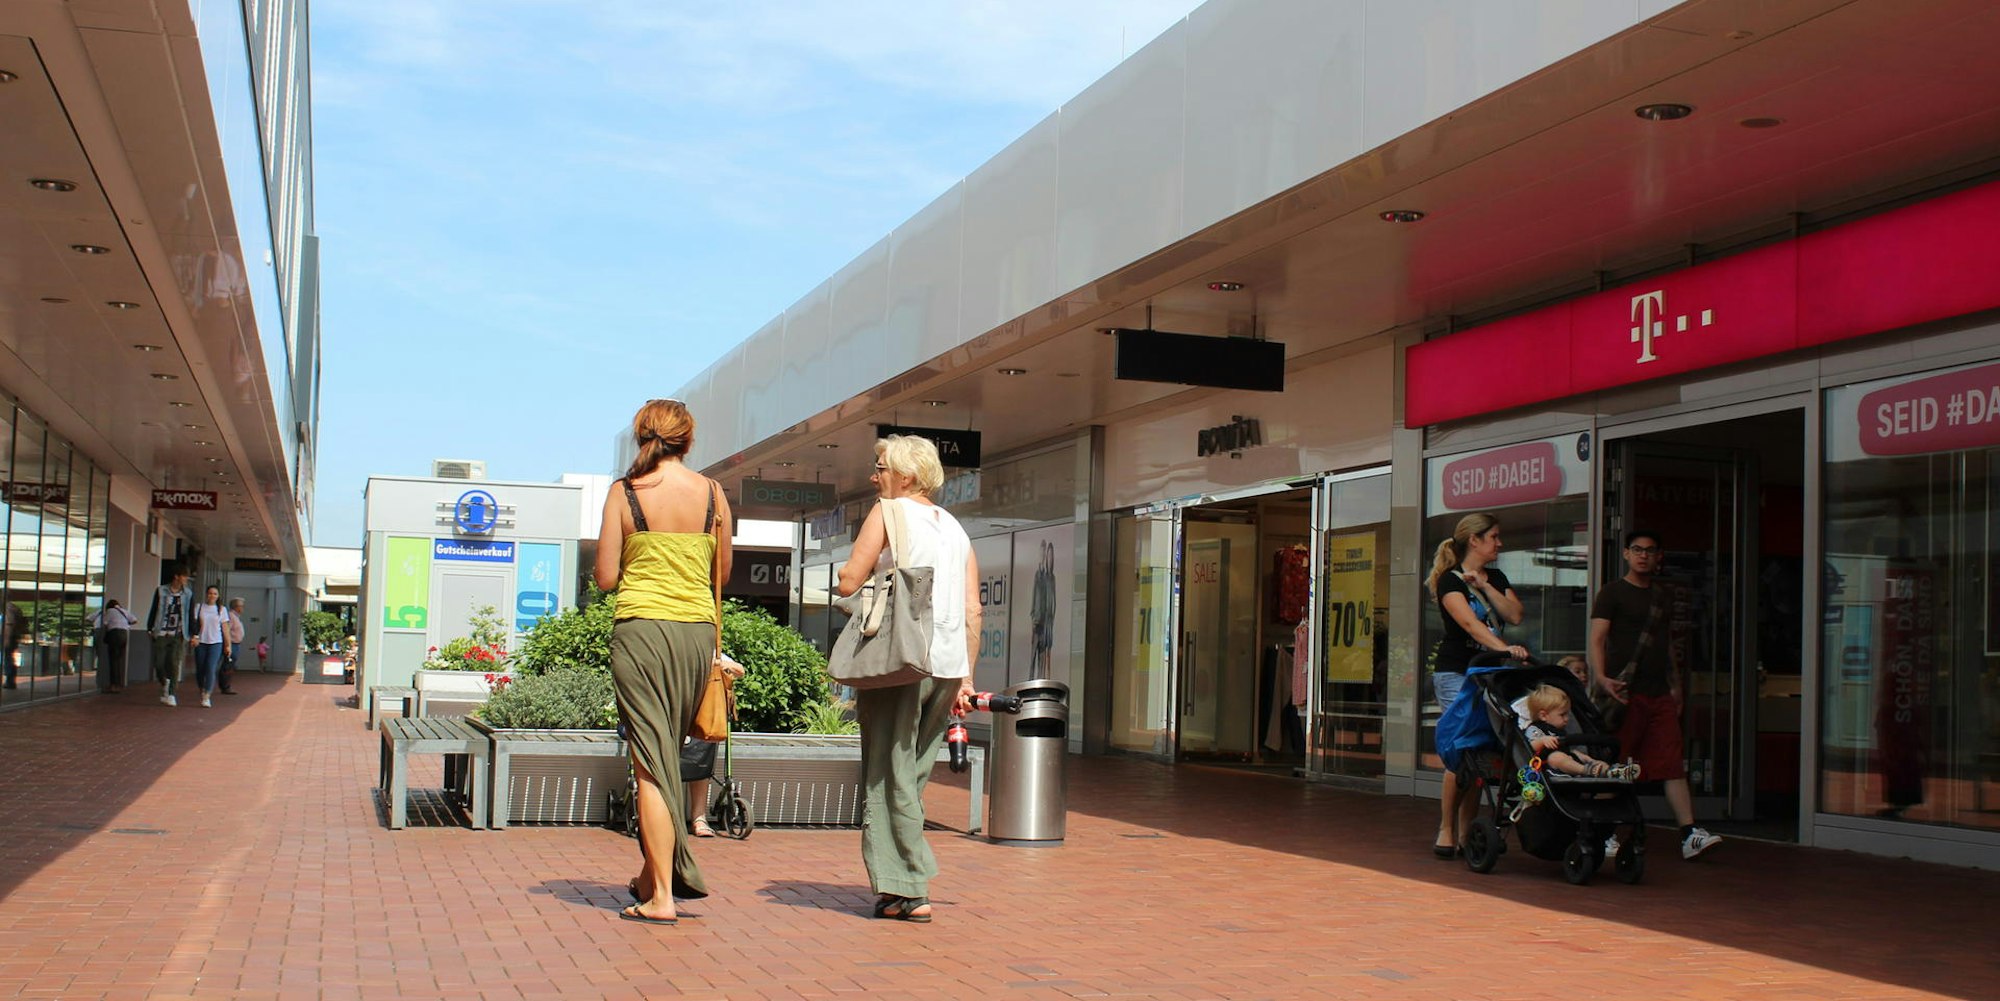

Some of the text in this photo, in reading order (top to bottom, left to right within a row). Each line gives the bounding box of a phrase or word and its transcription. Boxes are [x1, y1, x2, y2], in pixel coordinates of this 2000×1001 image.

[1877, 396, 1939, 438] SEID
[1452, 456, 1545, 497] SEID #DABEI
[435, 543, 513, 558] Gutscheinverkauf
[1194, 562, 1217, 584] SALE
[1332, 600, 1371, 648] 70%
